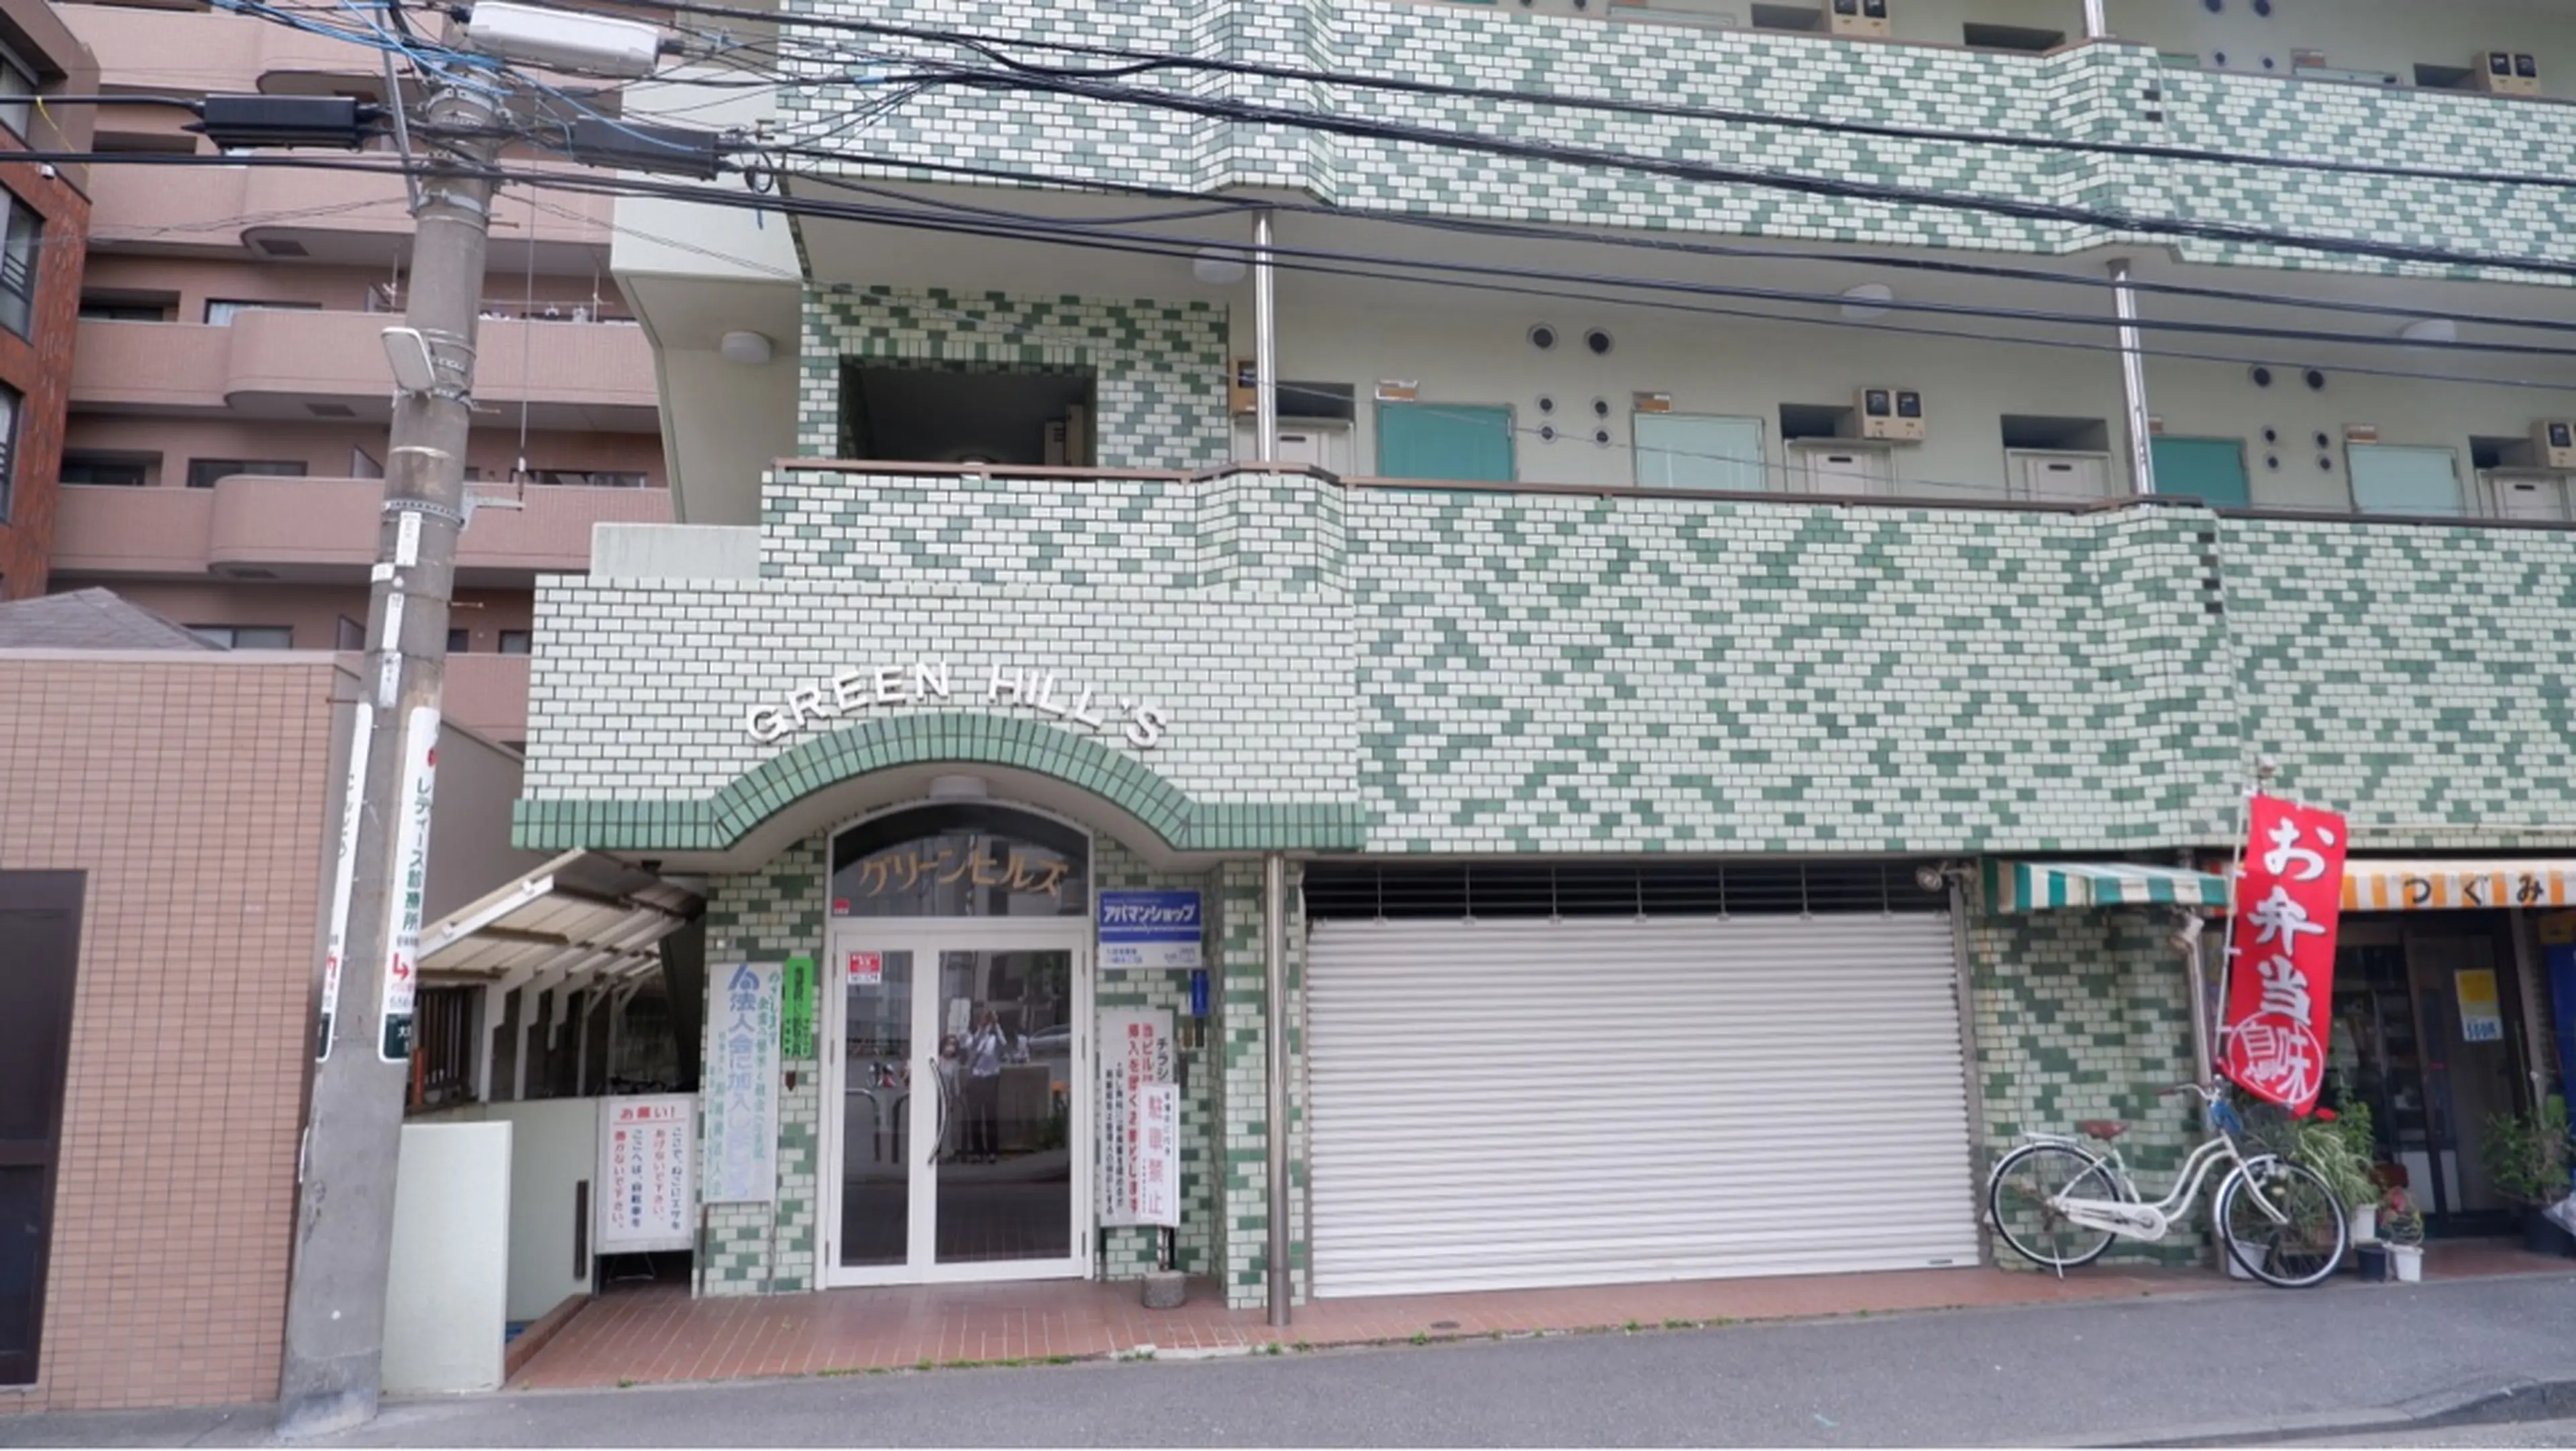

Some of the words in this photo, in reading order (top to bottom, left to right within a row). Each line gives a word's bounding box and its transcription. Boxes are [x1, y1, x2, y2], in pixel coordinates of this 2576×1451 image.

[744, 661, 949, 745] GREEN
[987, 662, 1167, 749] HILL'S
[1102, 902, 1196, 924] アパマンショップ
[2247, 817, 2335, 1025] お弁当
[2404, 873, 2544, 906] つぐみ
[1157, 1037, 1169, 1081] チラシ
[1148, 1095, 1164, 1216] 駐車禁止
